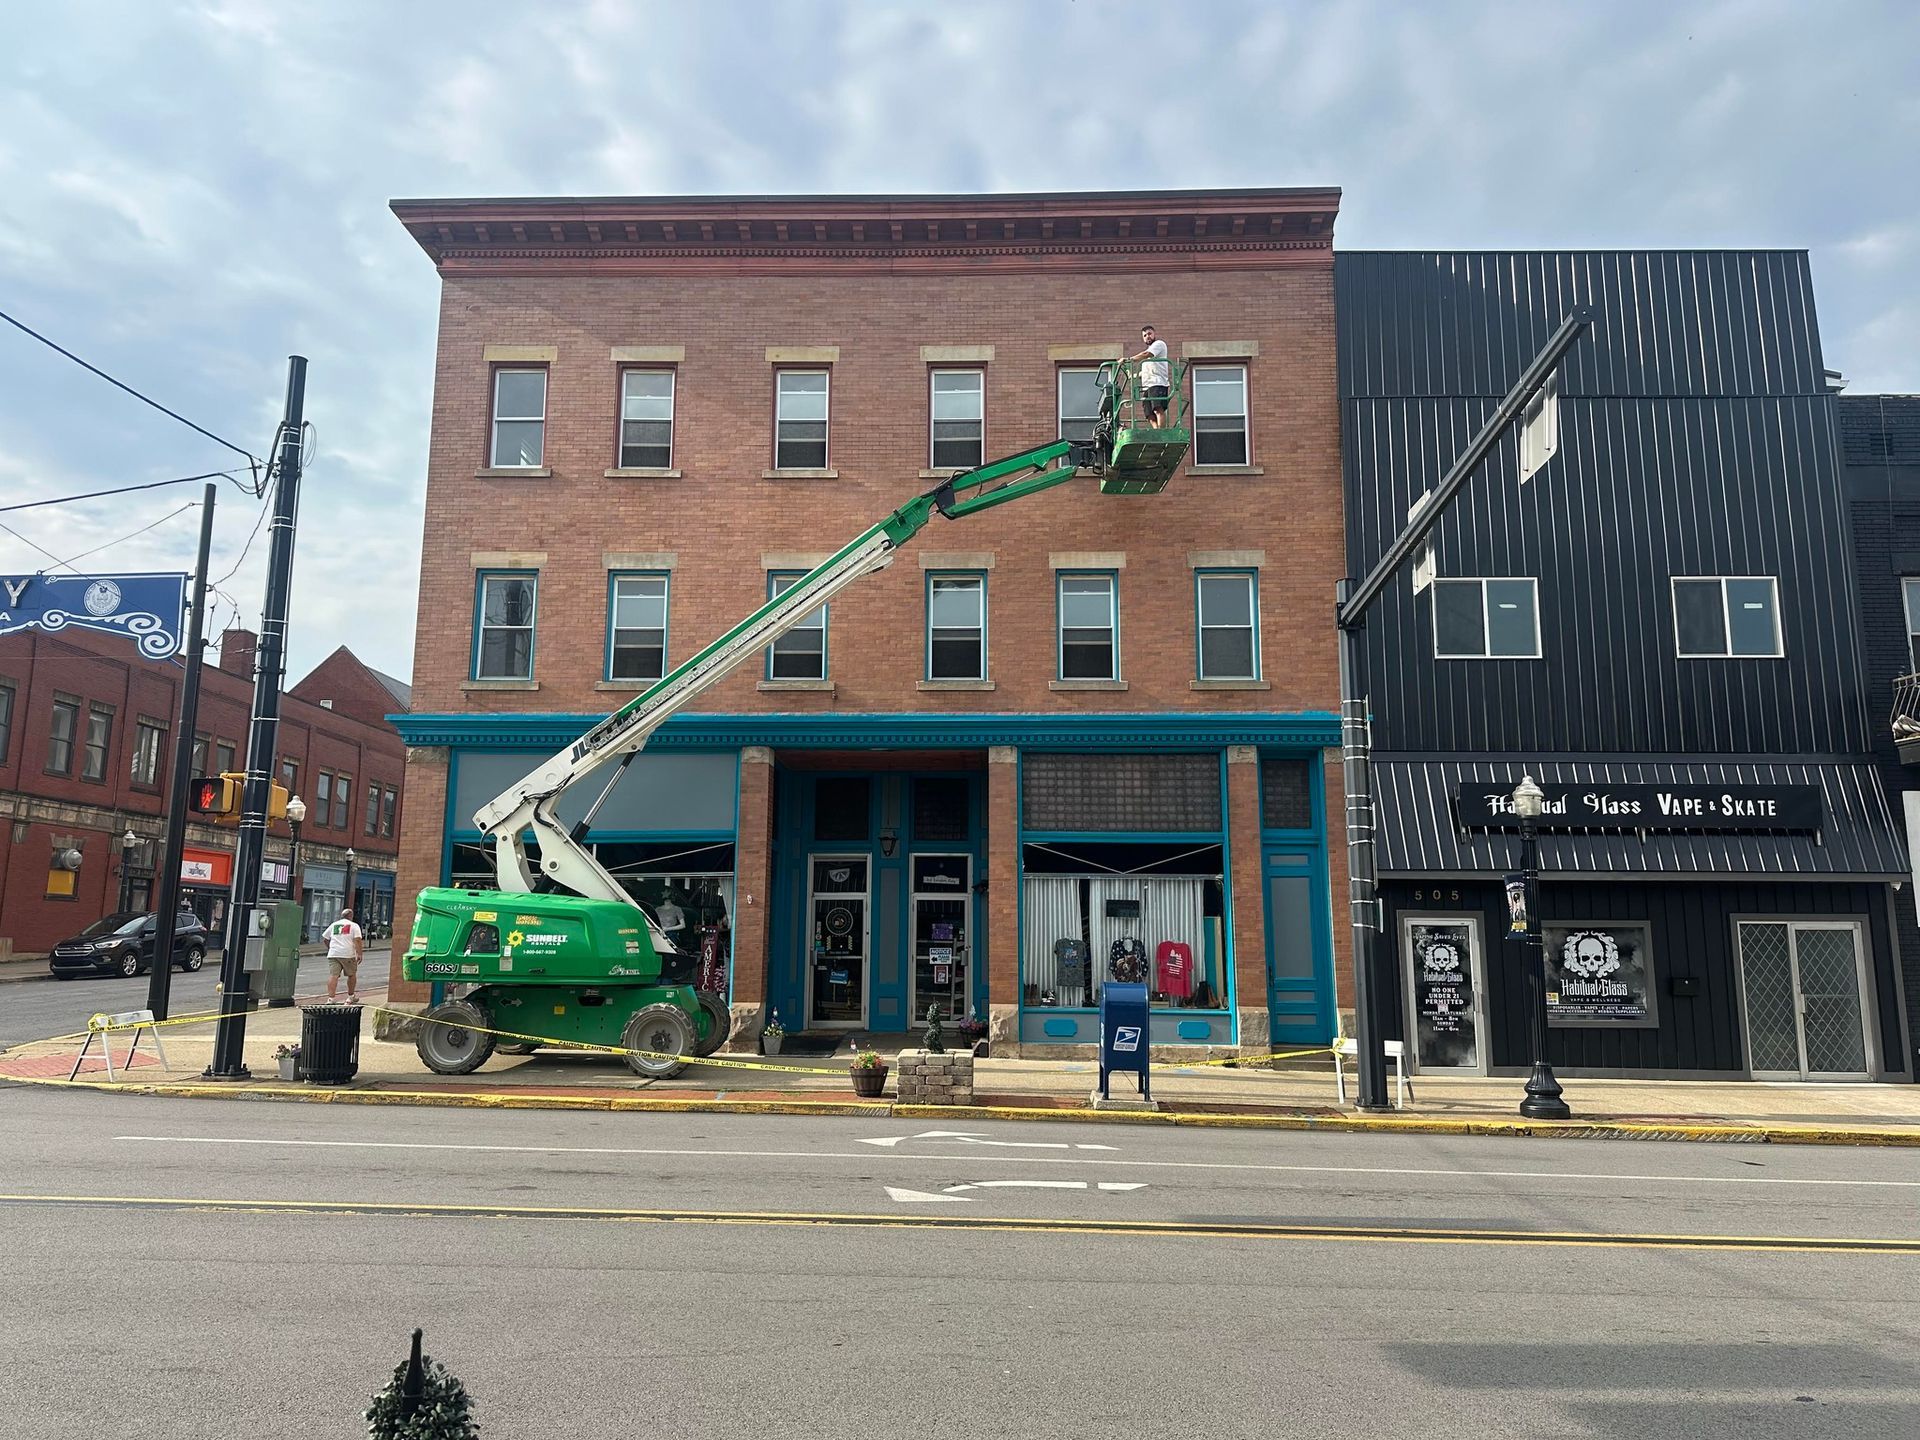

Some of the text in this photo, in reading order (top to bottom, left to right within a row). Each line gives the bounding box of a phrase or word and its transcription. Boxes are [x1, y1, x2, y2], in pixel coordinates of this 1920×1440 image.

[1483, 793, 1568, 817] Haual
[1583, 791, 1641, 815] Glass
[1709, 800, 1716, 811] &
[1415, 890, 1460, 900] 505
[526, 934, 568, 943] SUNBELT
[425, 963, 459, 974] 660SJ
[701, 944, 713, 992] AMERIC
[1560, 978, 1628, 997] Habitual Glass
[559, 1041, 585, 1050] CAUTION
[587, 1045, 612, 1053] CAUTION
[626, 1050, 652, 1058] CAUTION
[653, 1053, 680, 1061] CAUTION
[693, 1058, 719, 1066] CAUTION
[721, 1060, 747, 1068] CAUTION
